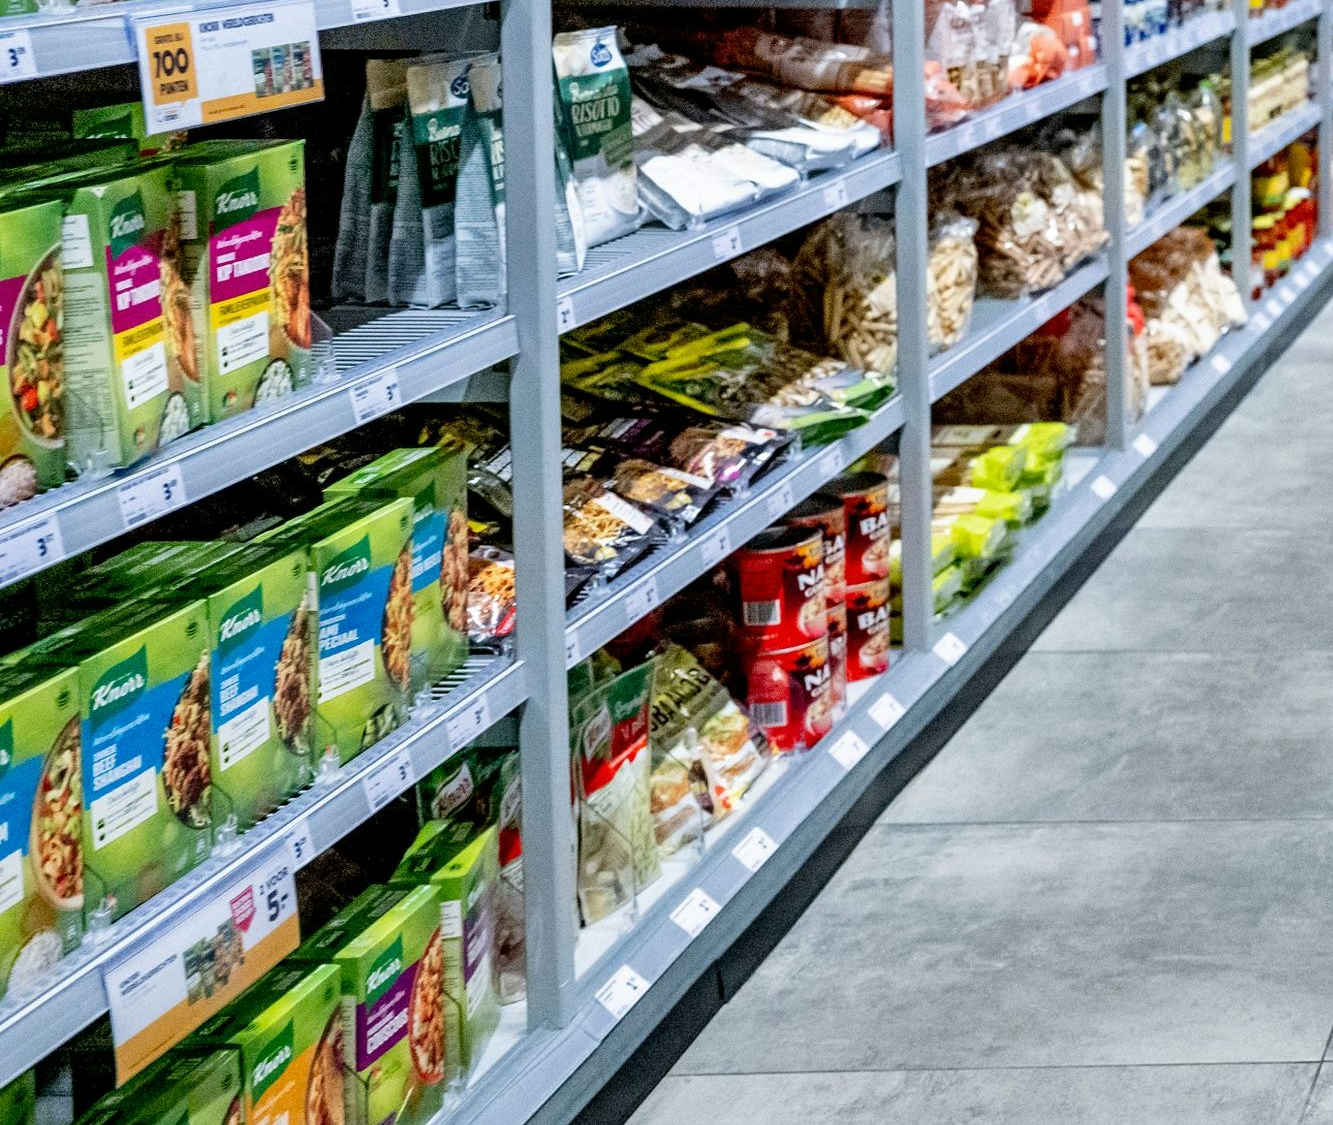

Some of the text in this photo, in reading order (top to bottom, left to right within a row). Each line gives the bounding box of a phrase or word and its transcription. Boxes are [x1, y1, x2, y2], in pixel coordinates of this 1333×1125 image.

[153, 47, 189, 79] 100
[215, 190, 260, 217] Knorr
[321, 557, 370, 587] Knorr
[220, 608, 261, 642] Knorr
[92, 674, 144, 711] Knorr
[366, 958, 402, 994] Knorr
[252, 1045, 292, 1087] Knorr
